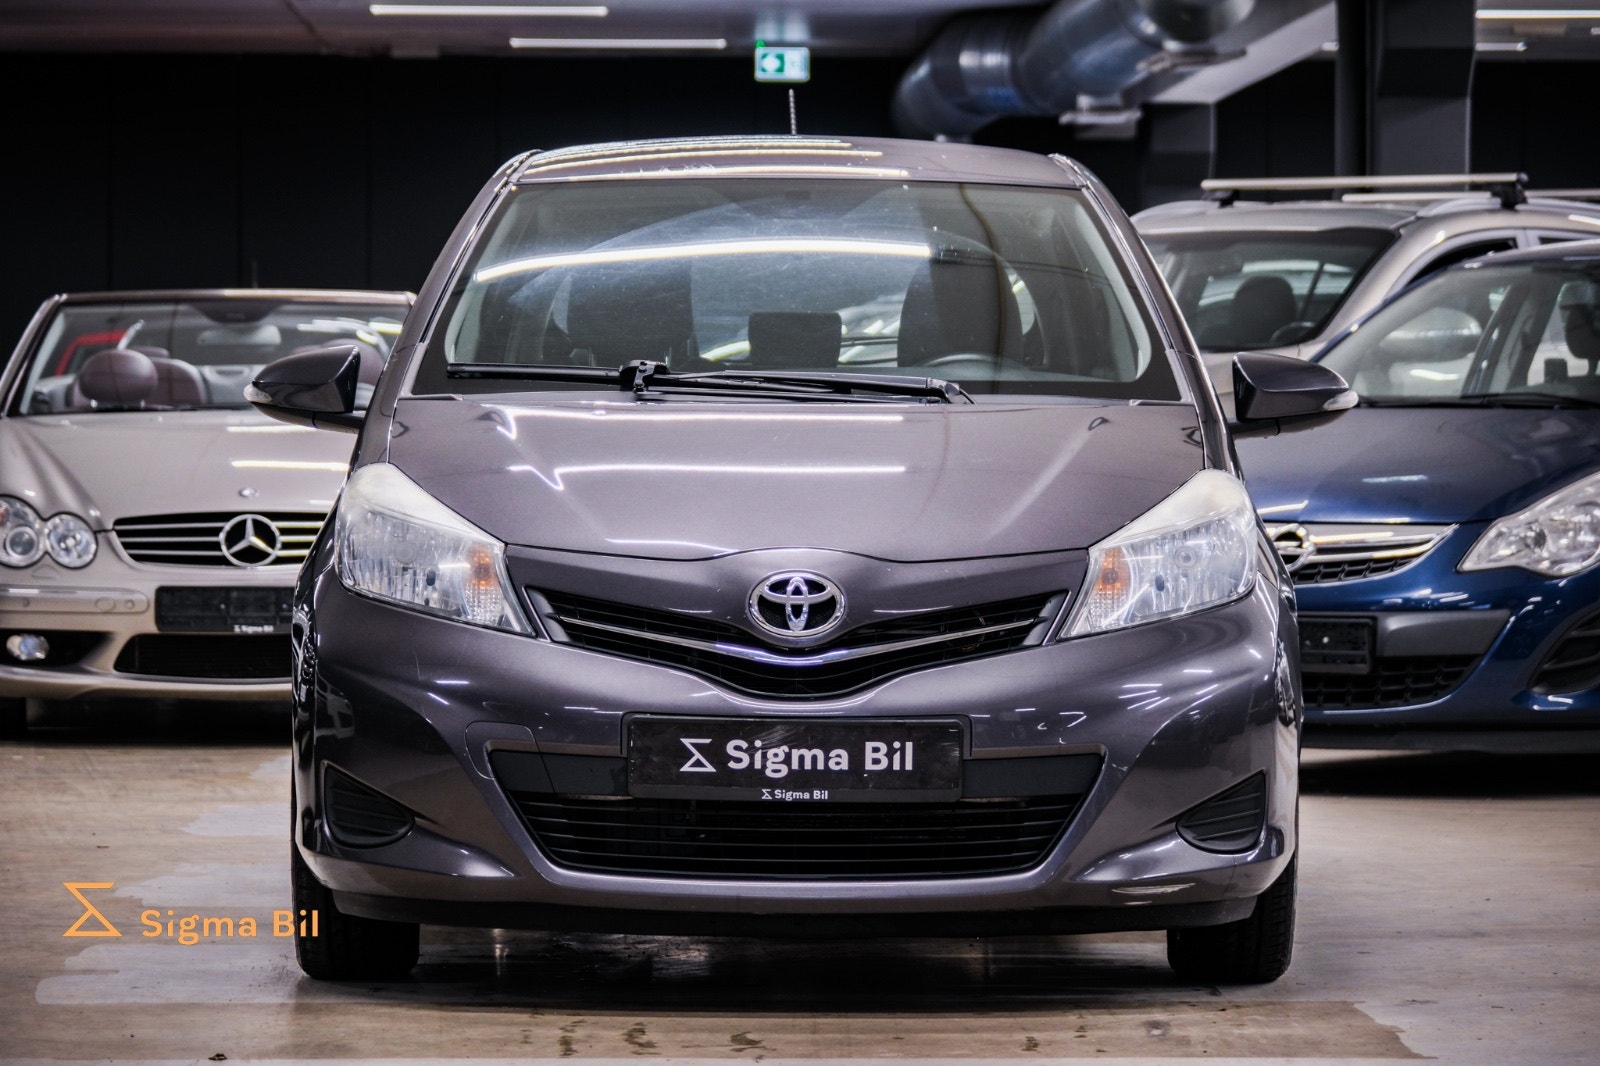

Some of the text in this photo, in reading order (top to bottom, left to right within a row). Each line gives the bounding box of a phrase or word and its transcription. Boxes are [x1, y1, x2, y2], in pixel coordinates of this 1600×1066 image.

[726, 739, 913, 779] Sigma Bil
[774, 789, 829, 801] Sigma Bil
